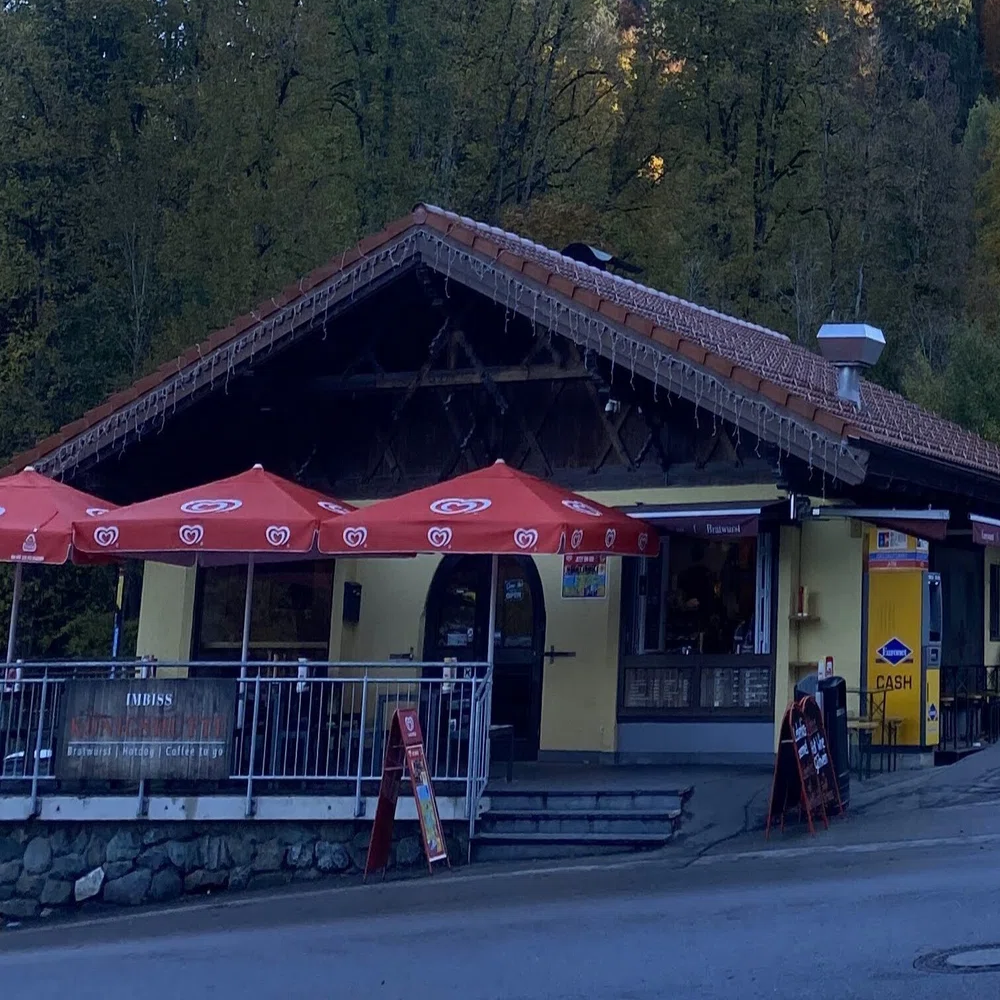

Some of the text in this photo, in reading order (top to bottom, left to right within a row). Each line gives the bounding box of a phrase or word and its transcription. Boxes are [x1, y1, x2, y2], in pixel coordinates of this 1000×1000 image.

[876, 675, 913, 690] CASH
[126, 693, 173, 706] IMBISS
[67, 745, 112, 757] Bratwurst
